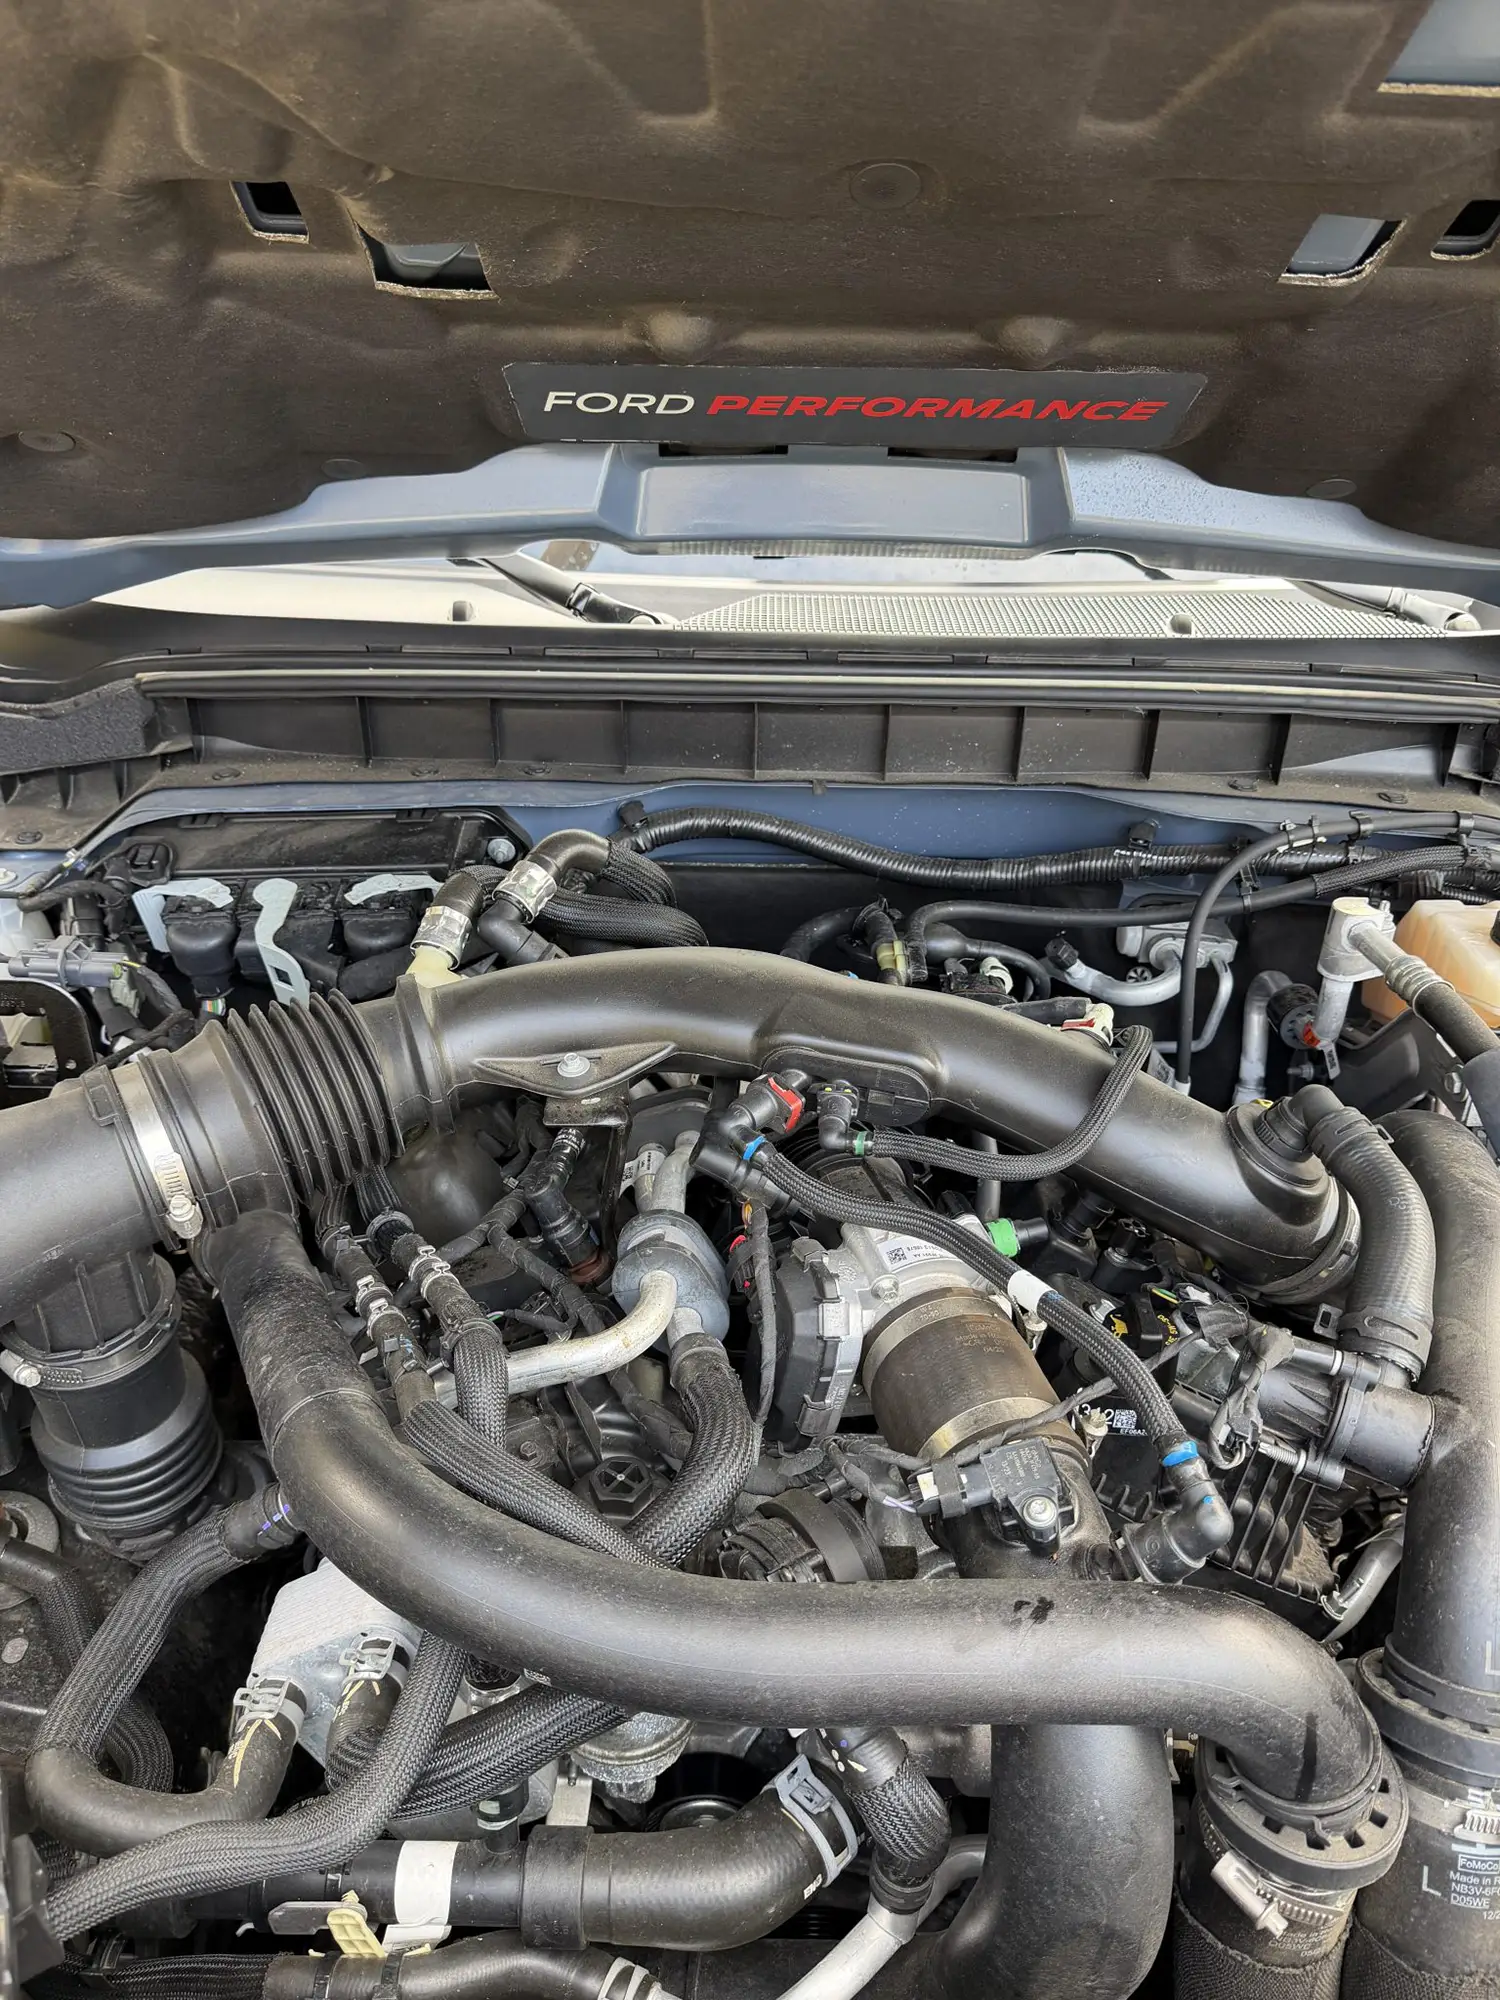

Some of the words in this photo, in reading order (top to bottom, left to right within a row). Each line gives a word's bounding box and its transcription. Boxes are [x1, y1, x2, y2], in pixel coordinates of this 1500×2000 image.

[543, 391, 695, 415] FORD
[706, 395, 1169, 421] PERFORMANCE
[1460, 1858, 1499, 1871] FoMoCo
[1450, 1870, 1480, 1885] Made
